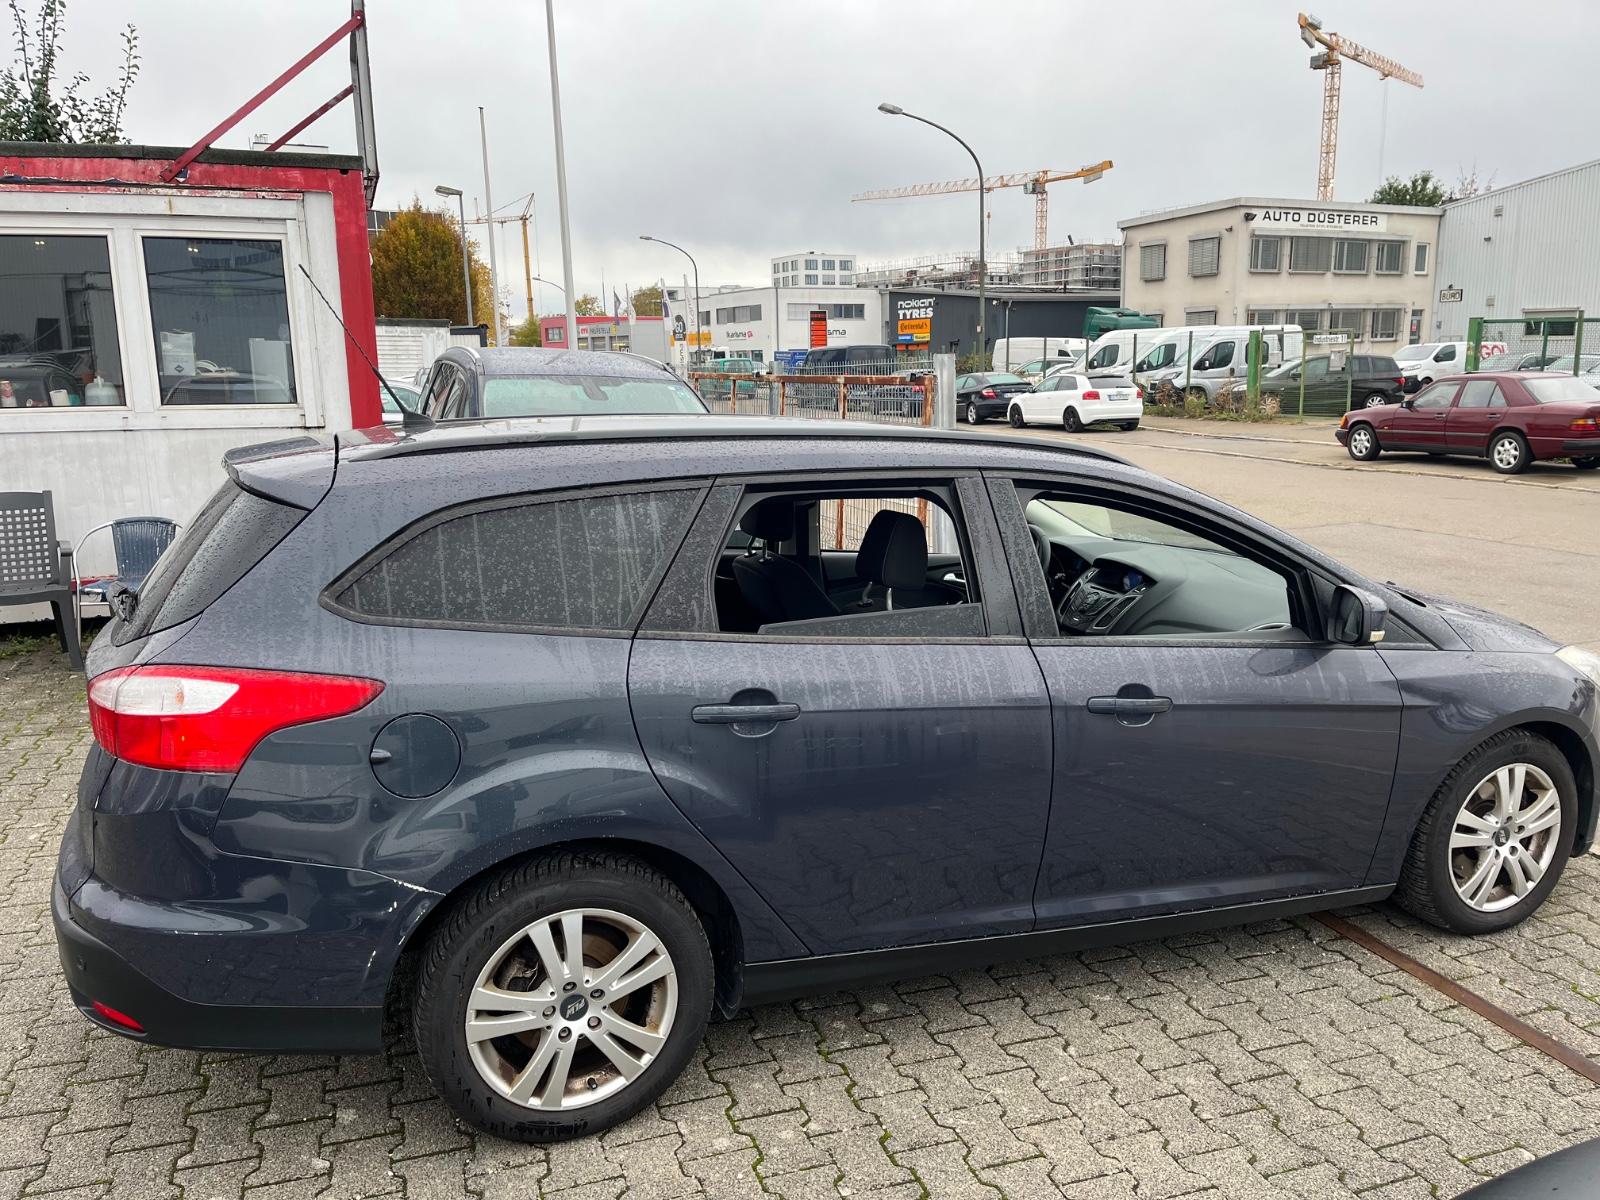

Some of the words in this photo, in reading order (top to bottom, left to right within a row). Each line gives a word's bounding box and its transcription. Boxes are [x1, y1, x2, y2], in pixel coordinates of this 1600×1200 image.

[1262, 210, 1301, 222] AUTO
[1307, 211, 1379, 226] DÜSTERER
[897, 307, 934, 320] TYRES
